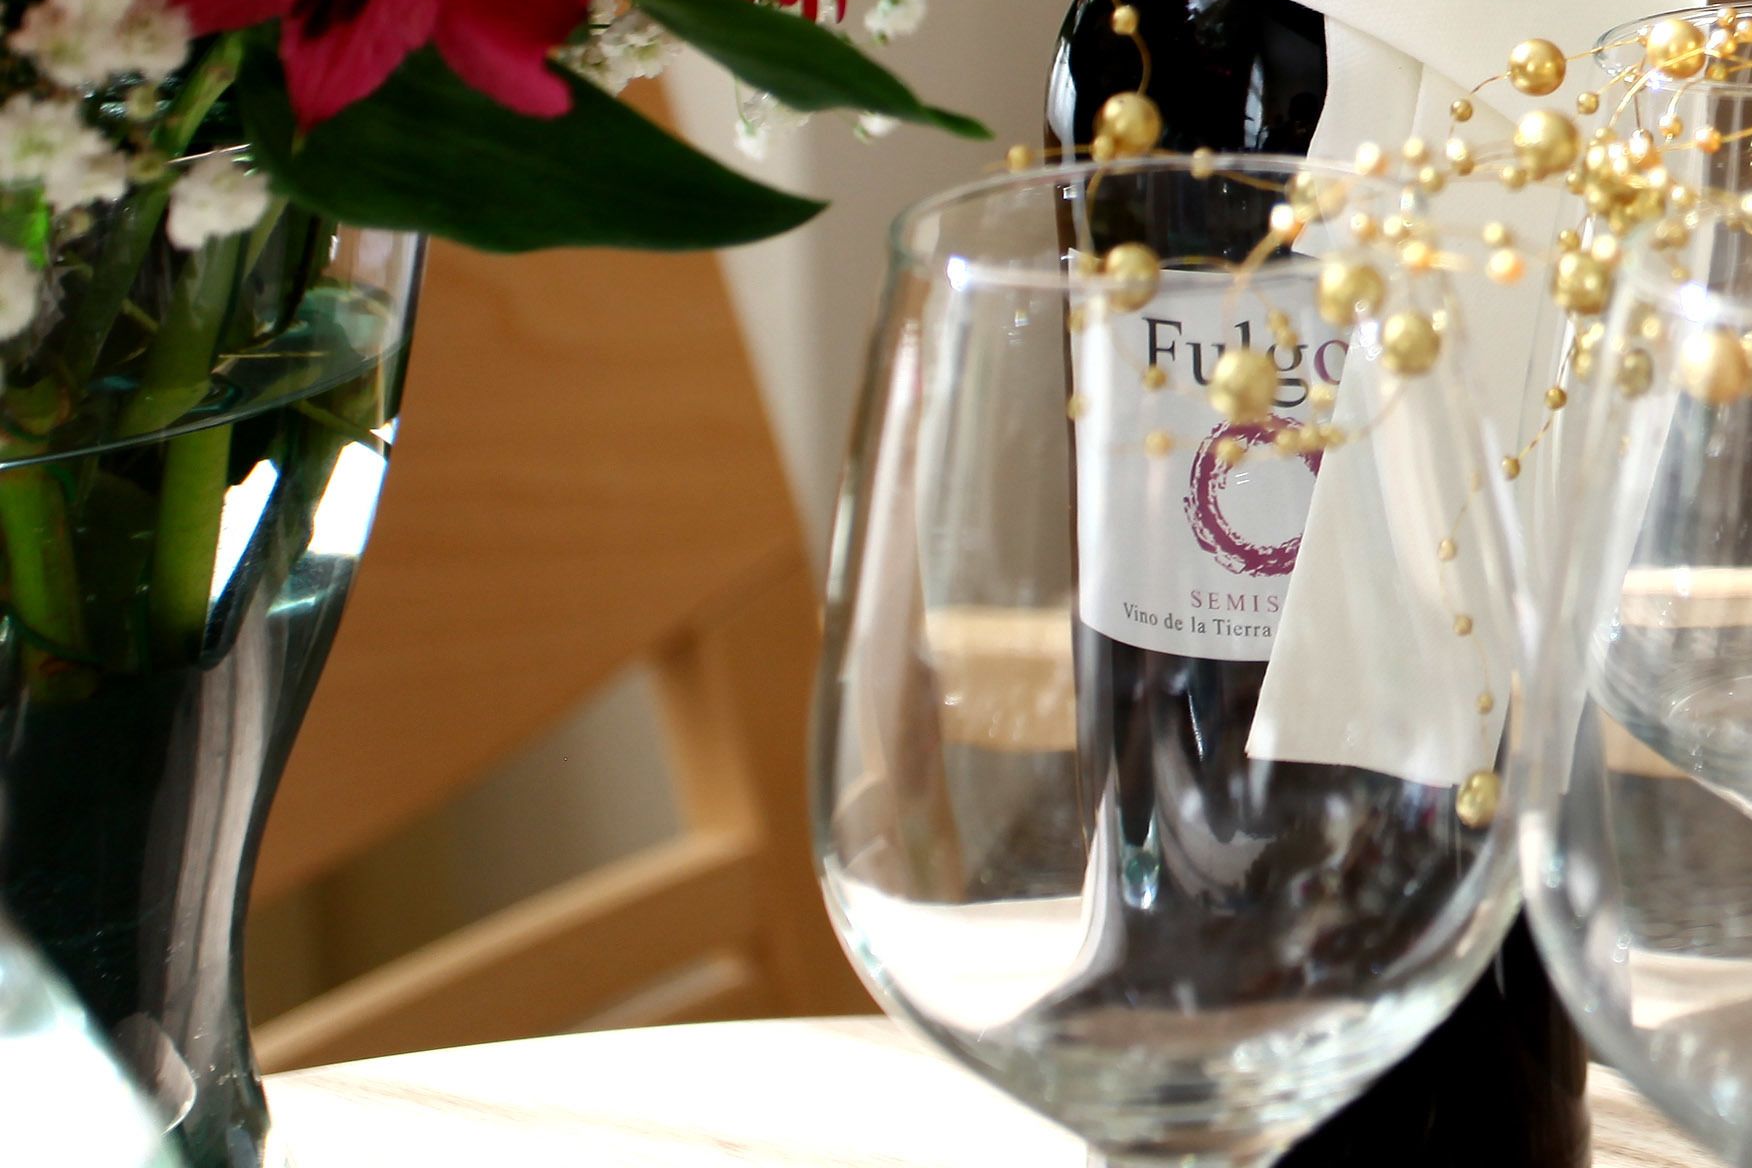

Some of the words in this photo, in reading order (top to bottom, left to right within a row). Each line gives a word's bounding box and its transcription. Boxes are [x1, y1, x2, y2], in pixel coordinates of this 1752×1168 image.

[1190, 590, 1280, 613] SEMIS
[1123, 601, 1158, 626] Vino
[1164, 612, 1184, 631] de
[1191, 616, 1206, 634] la
[1212, 618, 1272, 638] Tierra
